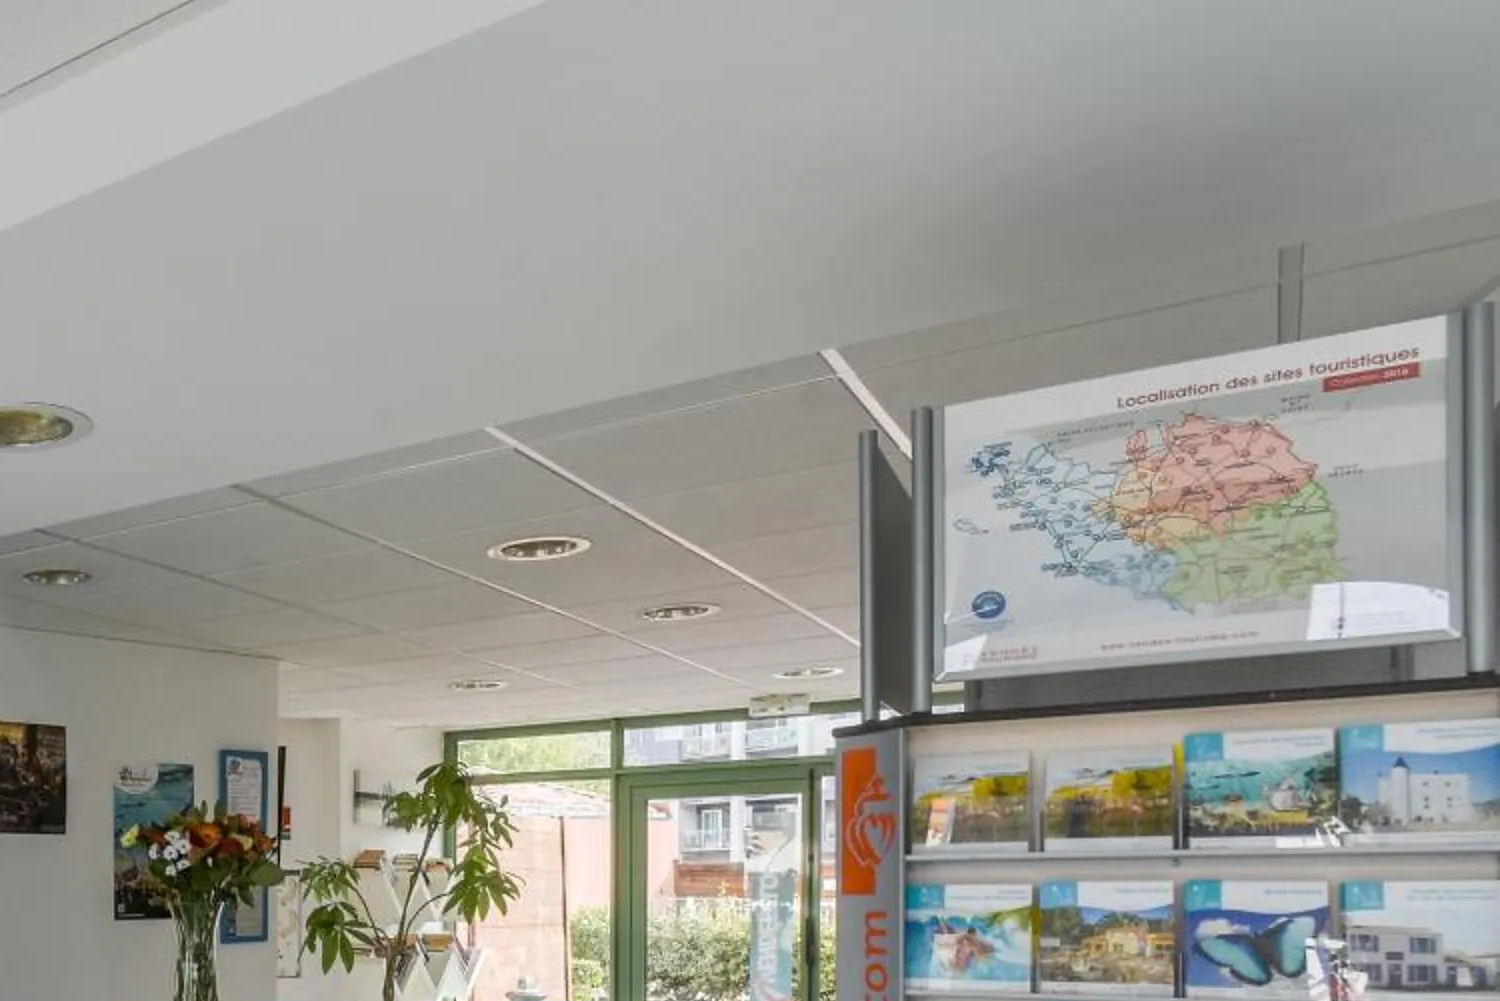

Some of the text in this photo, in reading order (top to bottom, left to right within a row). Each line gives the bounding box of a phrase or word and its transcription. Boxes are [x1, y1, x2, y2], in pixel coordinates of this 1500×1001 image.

[1117, 379, 1221, 409] Localisation
[1225, 374, 1258, 391] des
[1263, 365, 1303, 383] sites
[1309, 346, 1421, 375] touristiques
